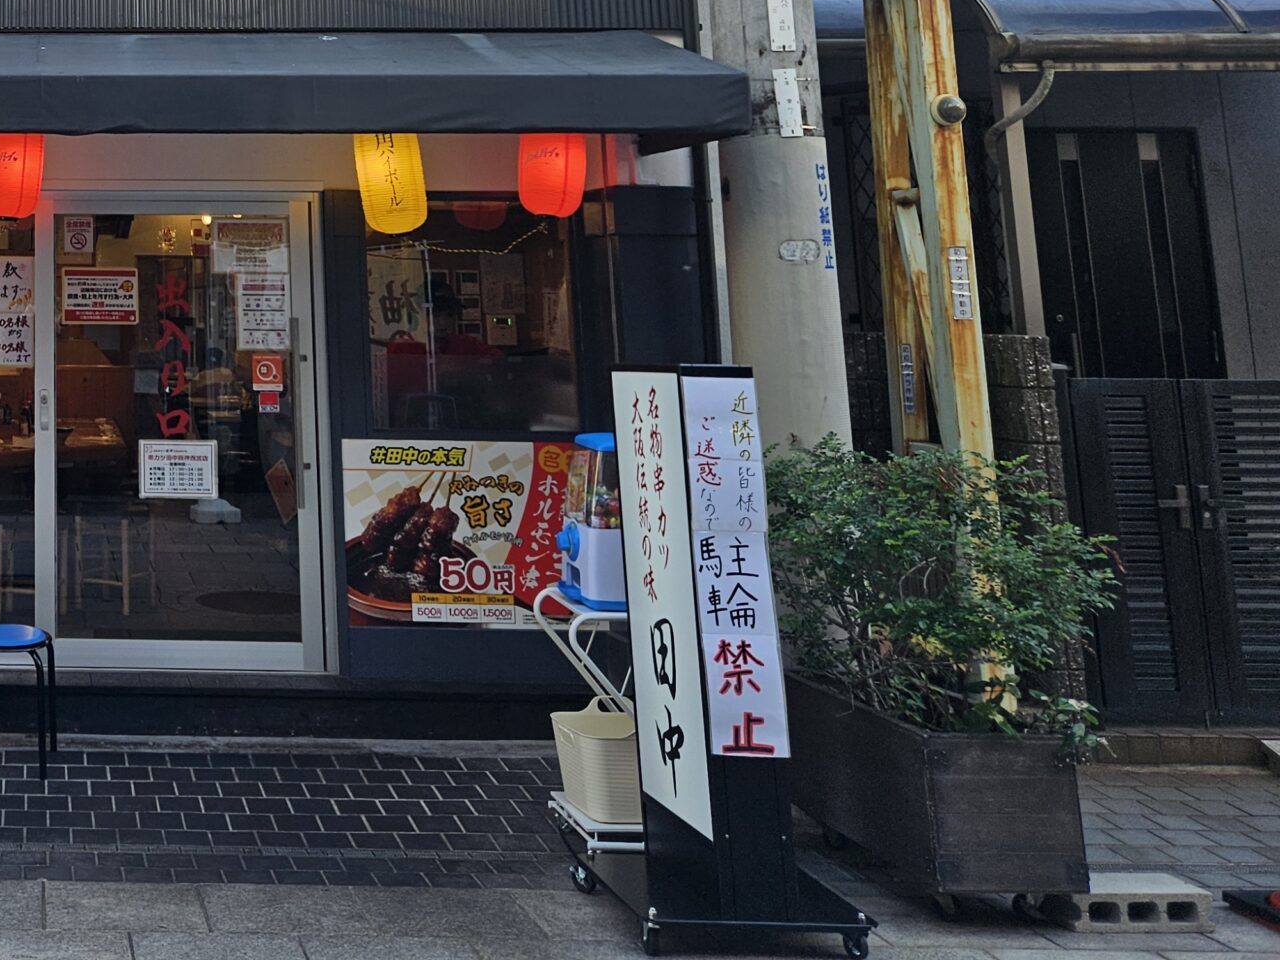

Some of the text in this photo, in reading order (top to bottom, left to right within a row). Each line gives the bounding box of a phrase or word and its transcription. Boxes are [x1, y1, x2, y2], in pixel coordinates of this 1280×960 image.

[815, 163, 835, 269] はり紙禁止
[370, 445, 466, 467] #田中の本気
[461, 494, 513, 528] 旨さ
[631, 390, 659, 603] 大阪伝統の味
[646, 386, 670, 571] 名物串カツ
[693, 415, 723, 532] ご迷惑なので
[730, 390, 760, 532] 近隣の皆様の
[439, 556, 516, 593] 50円
[648, 617, 686, 799] 田中
